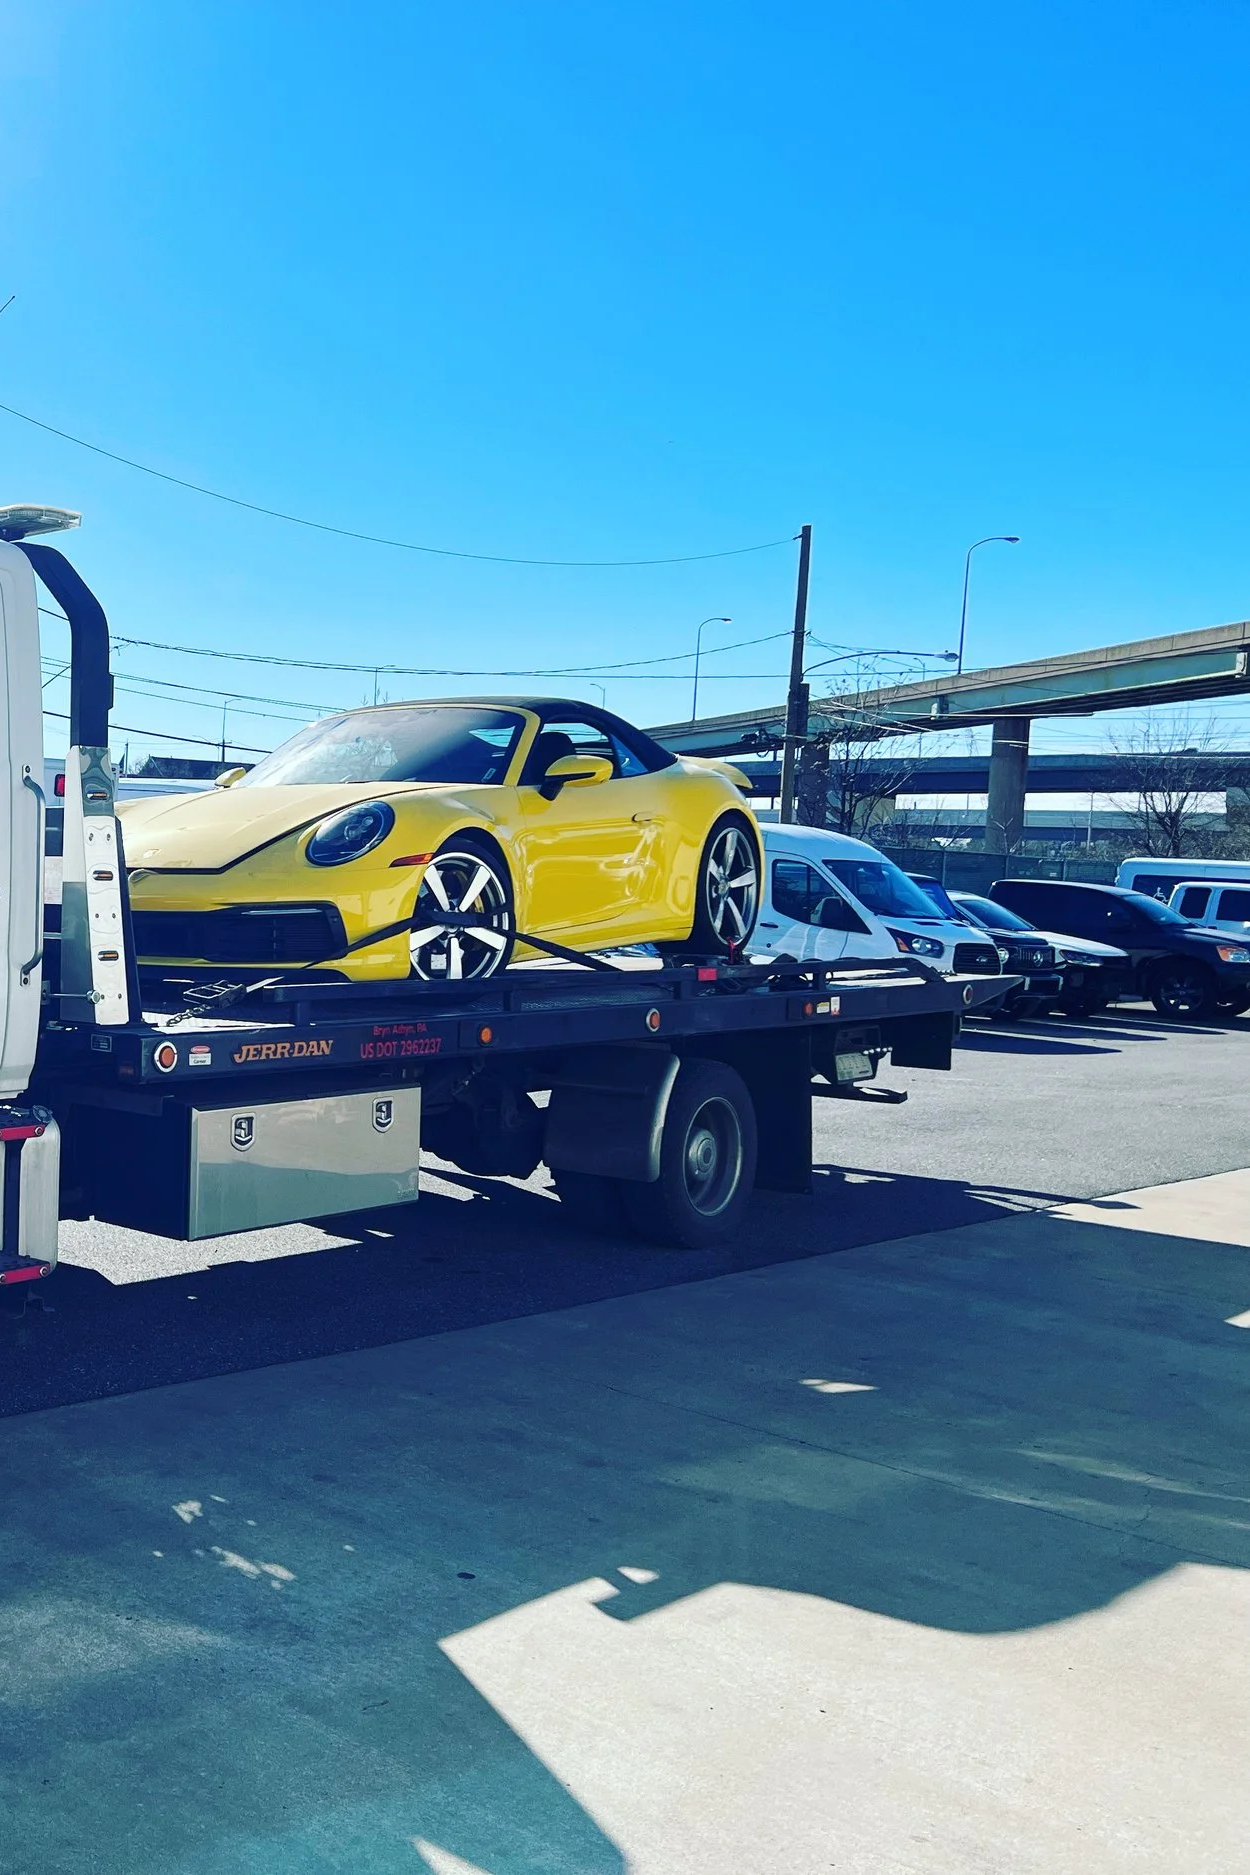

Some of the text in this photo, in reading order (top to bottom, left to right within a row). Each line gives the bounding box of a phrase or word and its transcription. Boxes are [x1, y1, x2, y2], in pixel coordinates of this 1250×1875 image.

[233, 1040, 334, 1064] JERR-DAN
[360, 1038, 442, 1059] US DOT 2962237
